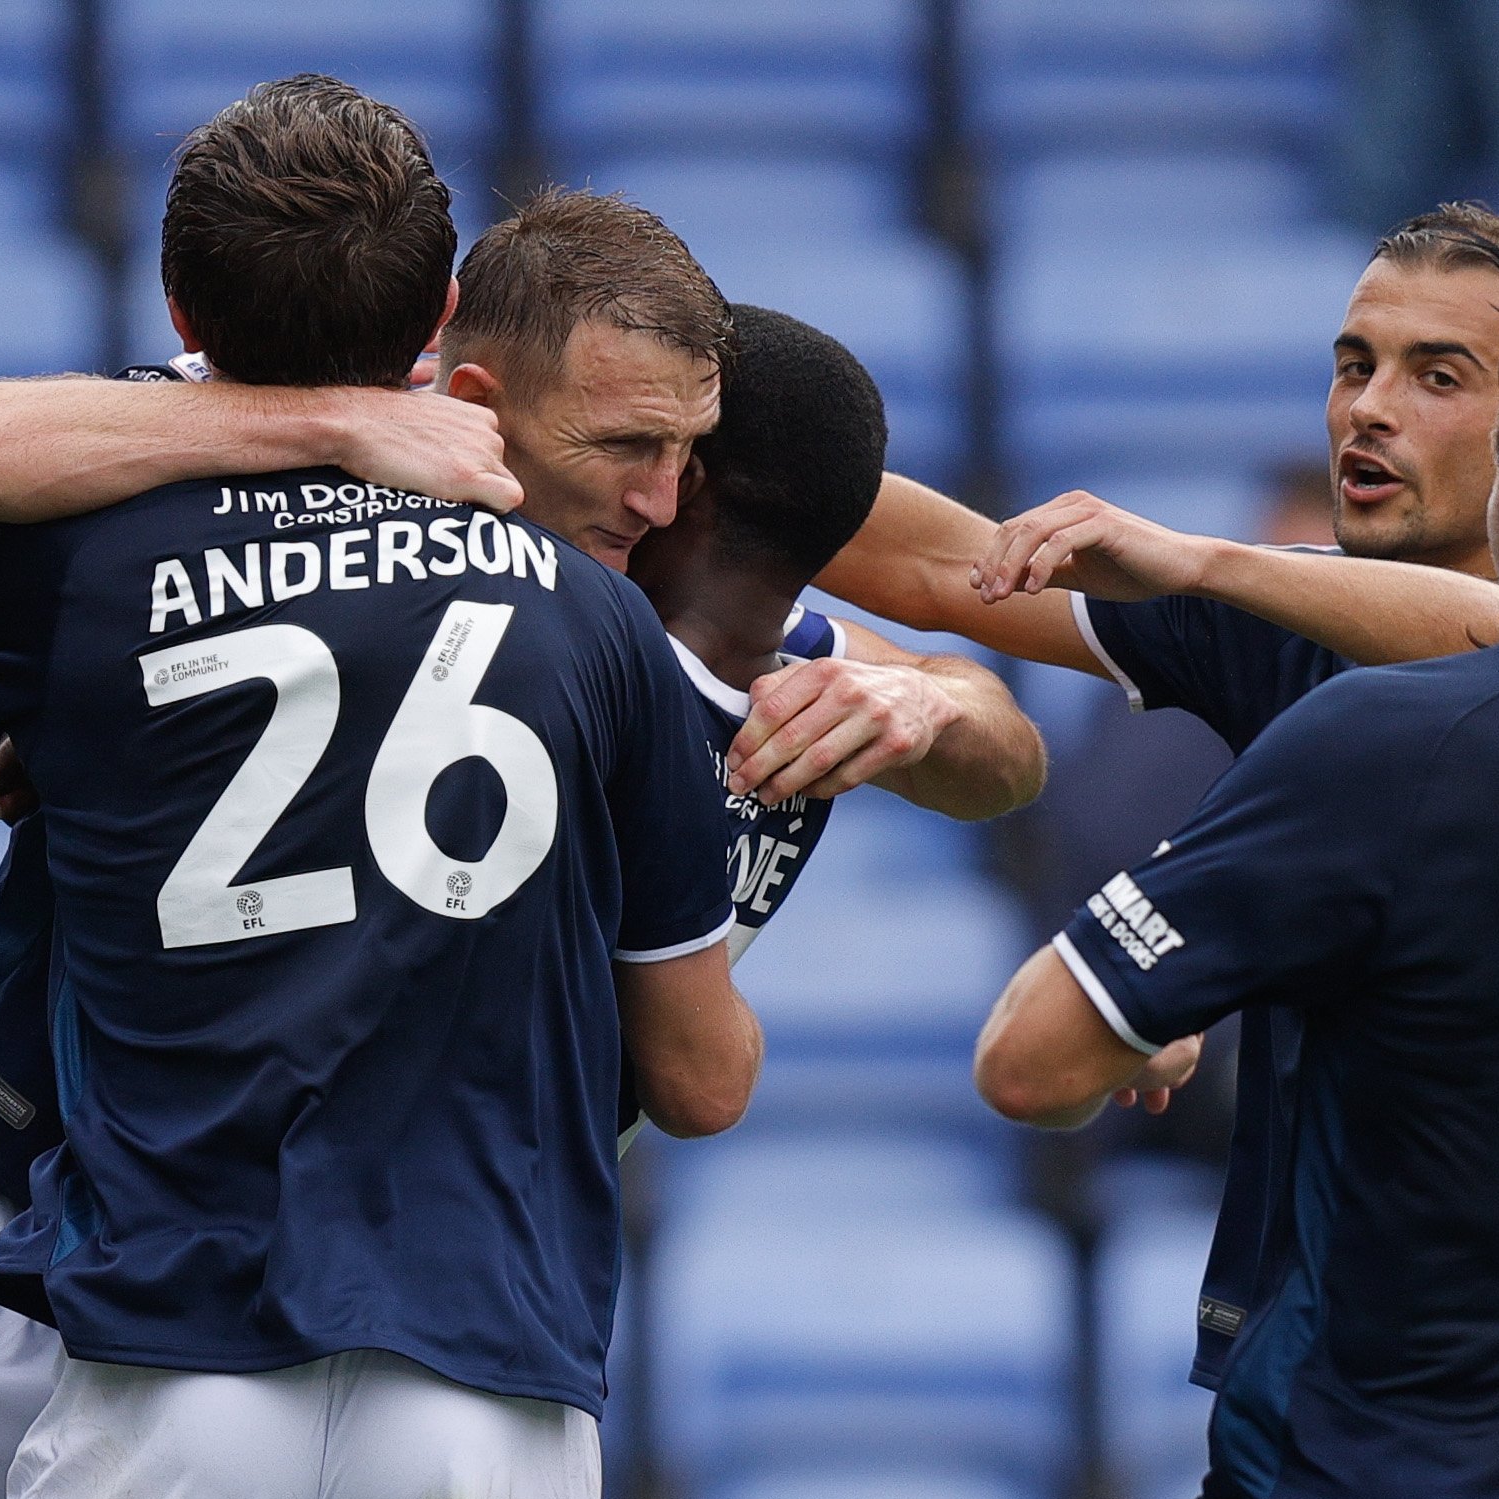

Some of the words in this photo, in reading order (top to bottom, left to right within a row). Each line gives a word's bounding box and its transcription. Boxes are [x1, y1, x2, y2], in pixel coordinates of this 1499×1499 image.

[213, 487, 287, 515] JIM
[148, 511, 558, 633] ANDERSON
[171, 662, 187, 673] EFL
[189, 659, 199, 669] IN
[202, 654, 219, 664] THE
[438, 648, 450, 663] EFL
[173, 660, 229, 681] COMMUNITY
[138, 600, 558, 949] 26
[445, 898, 466, 911] EFL
[243, 918, 266, 930] EFL
